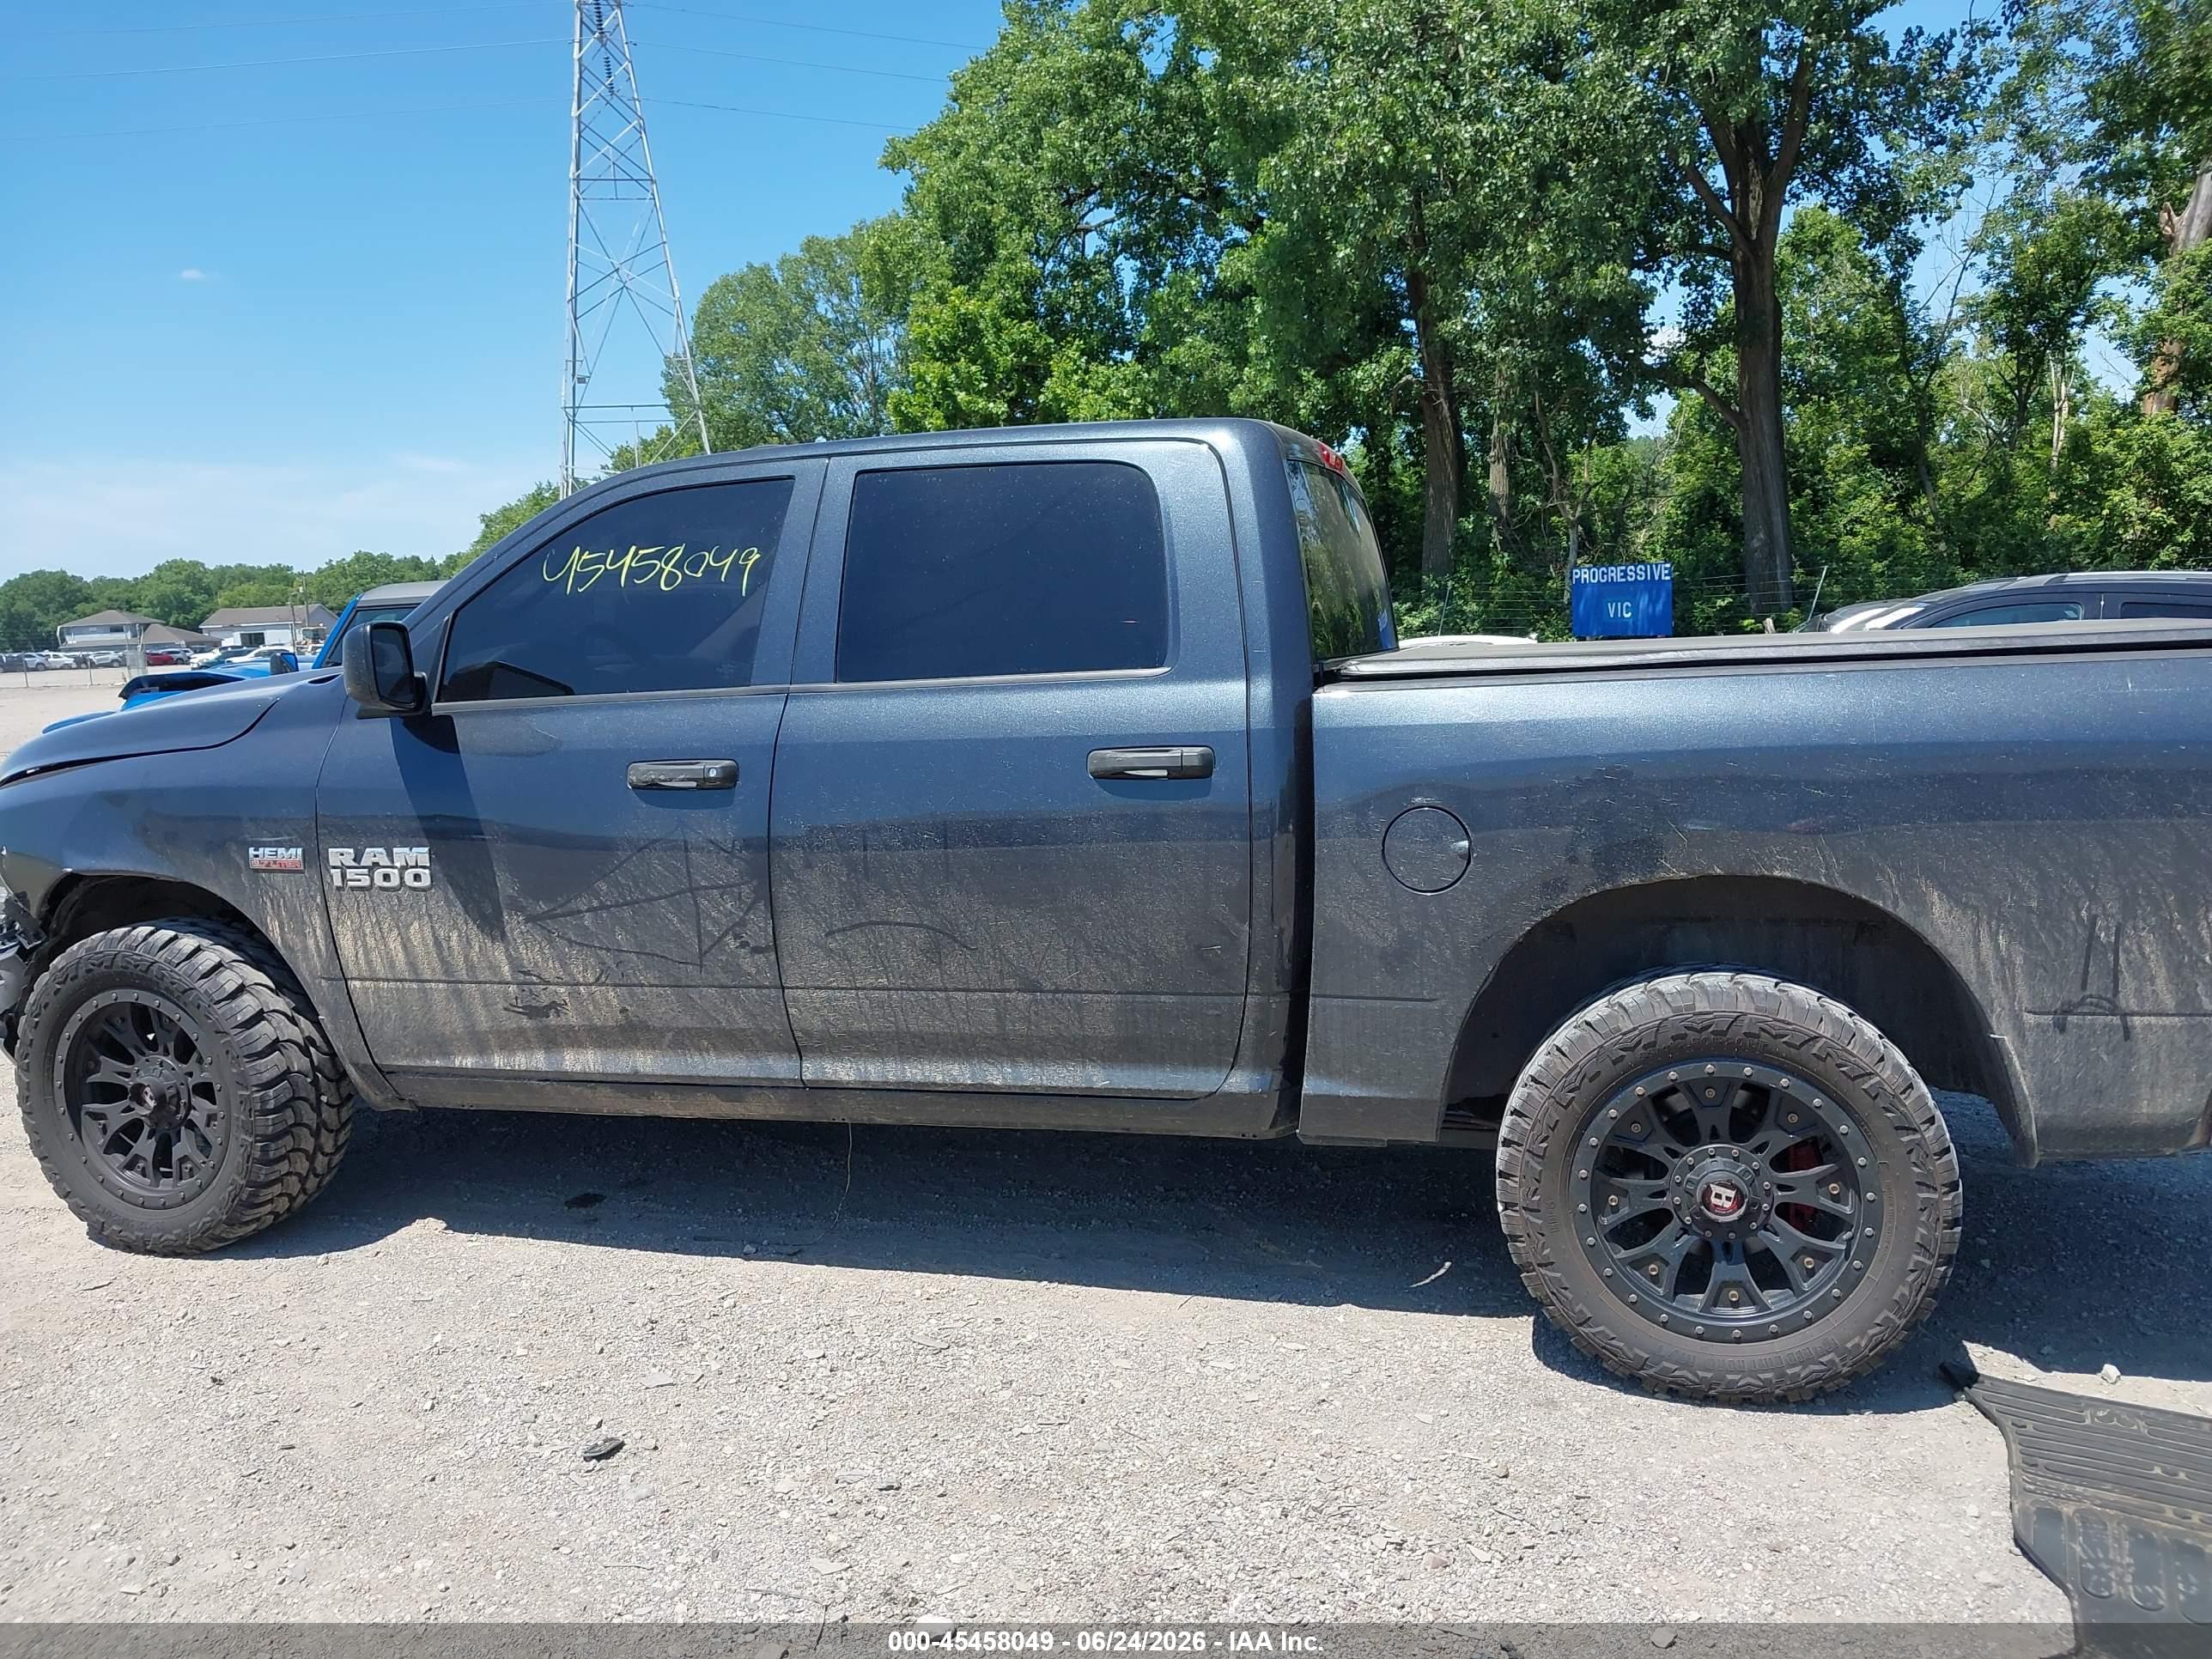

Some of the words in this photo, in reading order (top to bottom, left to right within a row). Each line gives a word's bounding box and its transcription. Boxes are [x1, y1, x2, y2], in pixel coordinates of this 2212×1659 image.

[543, 543, 761, 598] 45458049
[1572, 563, 1671, 584] PROGRESSIVE
[1607, 601, 1632, 618] VIC
[248, 847, 302, 859] HEMI
[328, 848, 430, 866] RAM
[330, 868, 431, 888] 1500
